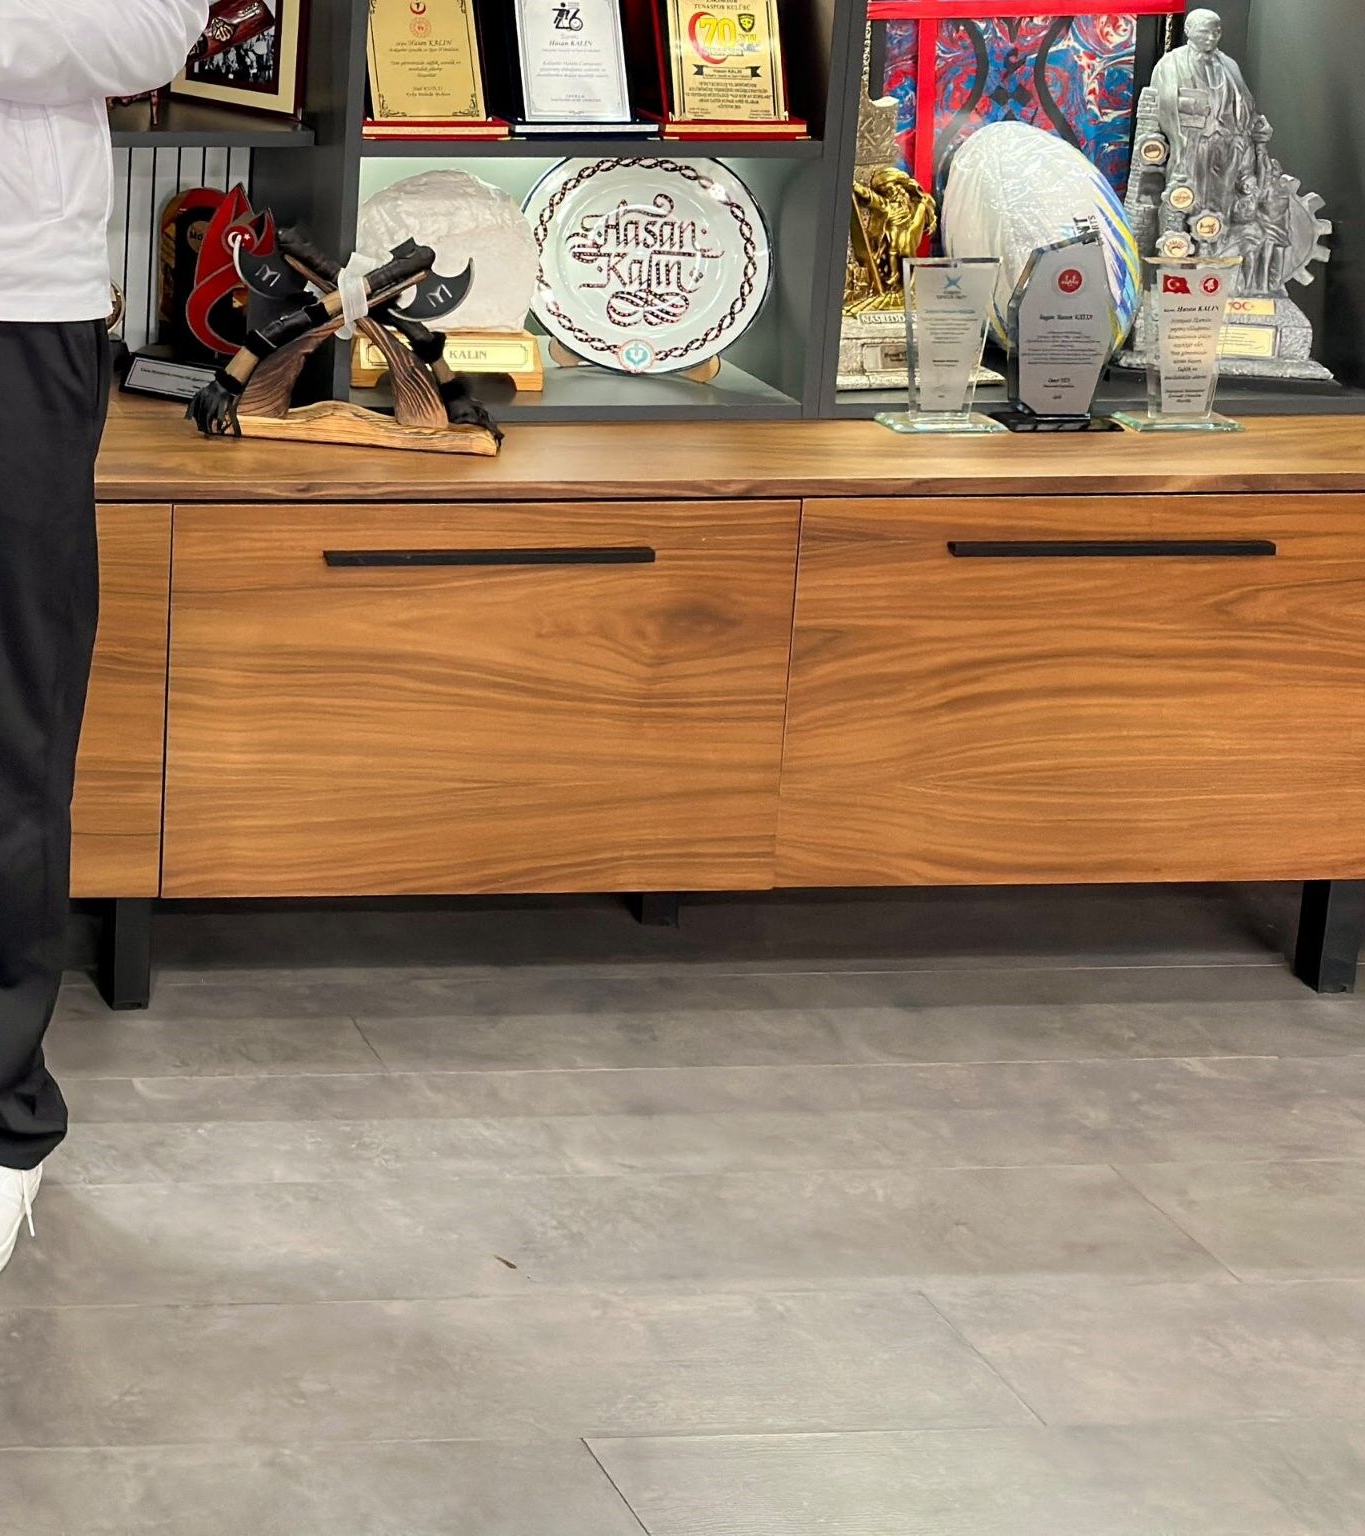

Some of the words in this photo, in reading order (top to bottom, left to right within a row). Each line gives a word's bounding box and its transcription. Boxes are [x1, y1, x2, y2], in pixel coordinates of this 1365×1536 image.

[699, 17, 737, 48] 70
[862, 313, 911, 324] NASREDD
[448, 349, 487, 361] KALIN
